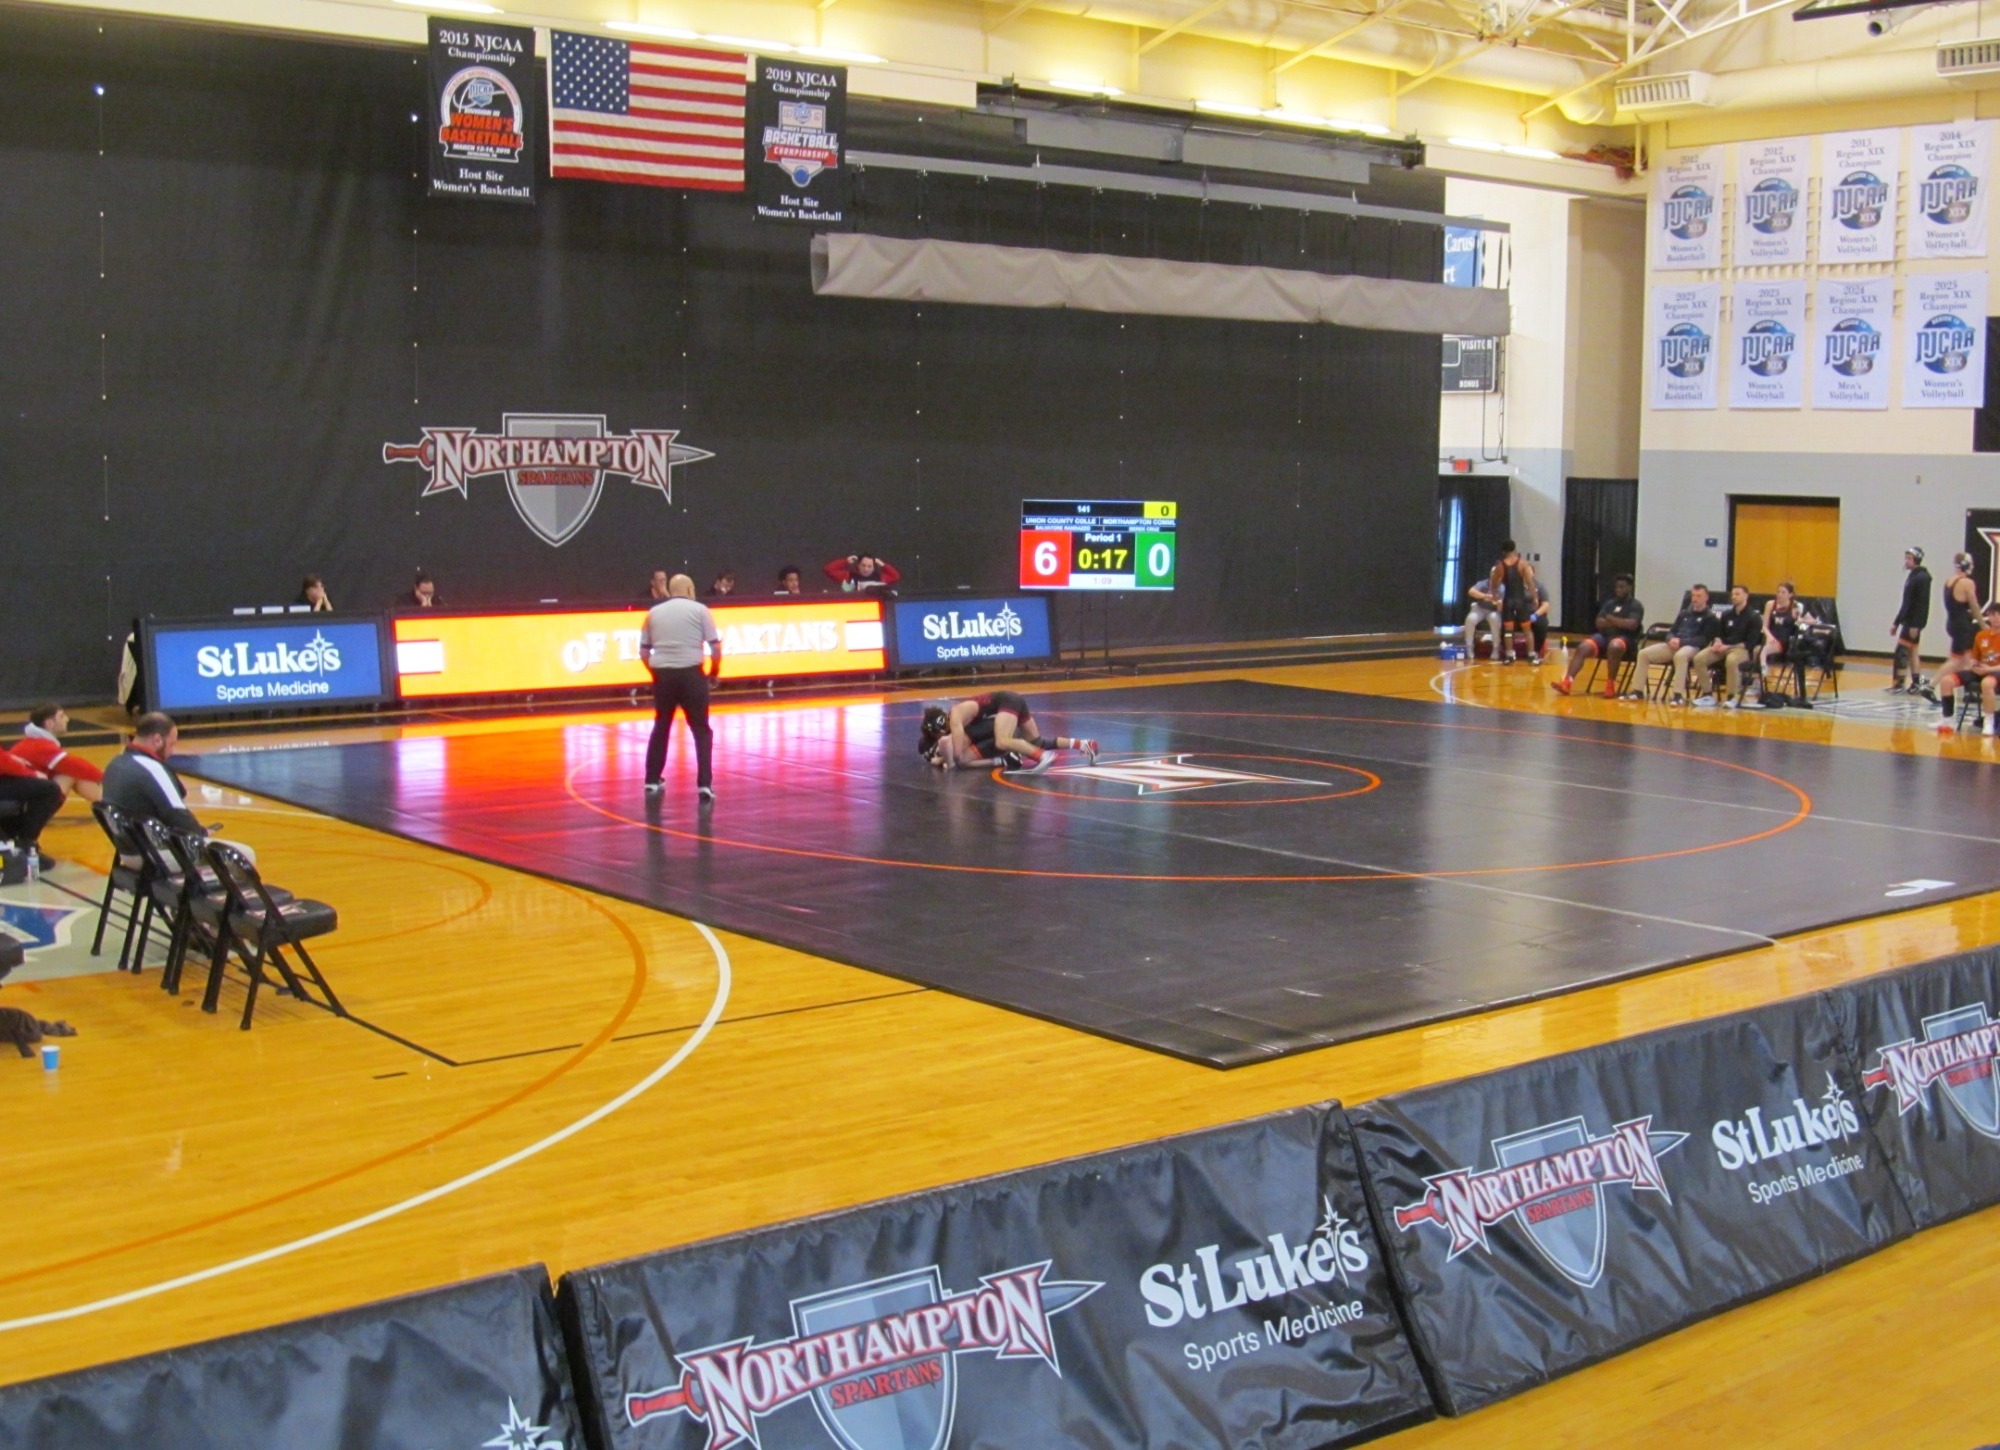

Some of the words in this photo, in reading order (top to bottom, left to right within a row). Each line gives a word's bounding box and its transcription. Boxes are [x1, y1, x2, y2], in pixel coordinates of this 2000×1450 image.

[440, 30, 469, 46] 2015
[475, 33, 523, 52] NJCAA
[448, 46, 516, 66] Championship
[766, 67, 792, 83] 2019
[795, 71, 837, 88] NJCAA
[773, 82, 831, 100] Championship
[451, 113, 514, 131] WOMEN'S
[441, 127, 522, 149] BASKETBALL
[763, 128, 839, 151] BASKETBALL
[459, 168, 482, 180] Host
[485, 170, 504, 182] Site
[433, 179, 477, 193] Women's
[480, 183, 530, 197] Basketball
[1919, 176, 1978, 214] NJCAA
[780, 195, 800, 206] Host
[803, 197, 819, 207] Site
[1663, 195, 1713, 230] NJCAA
[1746, 188, 1799, 224] NJCAA
[1832, 183, 1888, 219] NJCAA
[758, 206, 795, 218] Women's
[798, 210, 842, 221] Basketball
[1660, 333, 1712, 367] NJCAA
[1741, 331, 1796, 366] NJCAA
[1824, 330, 1882, 365] NJCAA
[1915, 327, 1976, 364] NJCAA
[421, 427, 680, 505] NORTHAMPTON
[517, 470, 595, 488] SPARTANS
[1077, 505, 1091, 514] 141
[1160, 505, 1170, 517] 0
[1103, 518, 1152, 526] NORTHAMPTON
[1085, 533, 1115, 543] Period
[1116, 533, 1122, 543] 1
[1034, 541, 1058, 576] 6
[1078, 548, 1128, 570] 0:17
[1148, 542, 1171, 577] 0
[563, 631, 607, 673] OF
[937, 645, 969, 660] Sports
[971, 643, 1015, 657] Medicine
[216, 684, 263, 702] Sports
[267, 680, 330, 698] Medicine
[1421, 1115, 1673, 1263] NORTHAMPTON
[1748, 1172, 1799, 1205] Sports
[1797, 1152, 1865, 1188] Medicine
[1525, 1188, 1596, 1225] SPARTANS
[1183, 1330, 1260, 1372] Sports
[1264, 1299, 1364, 1346] Medicine
[675, 1260, 1061, 1450] NORTHAMPTON
[829, 1358, 943, 1410] SPARTANS
